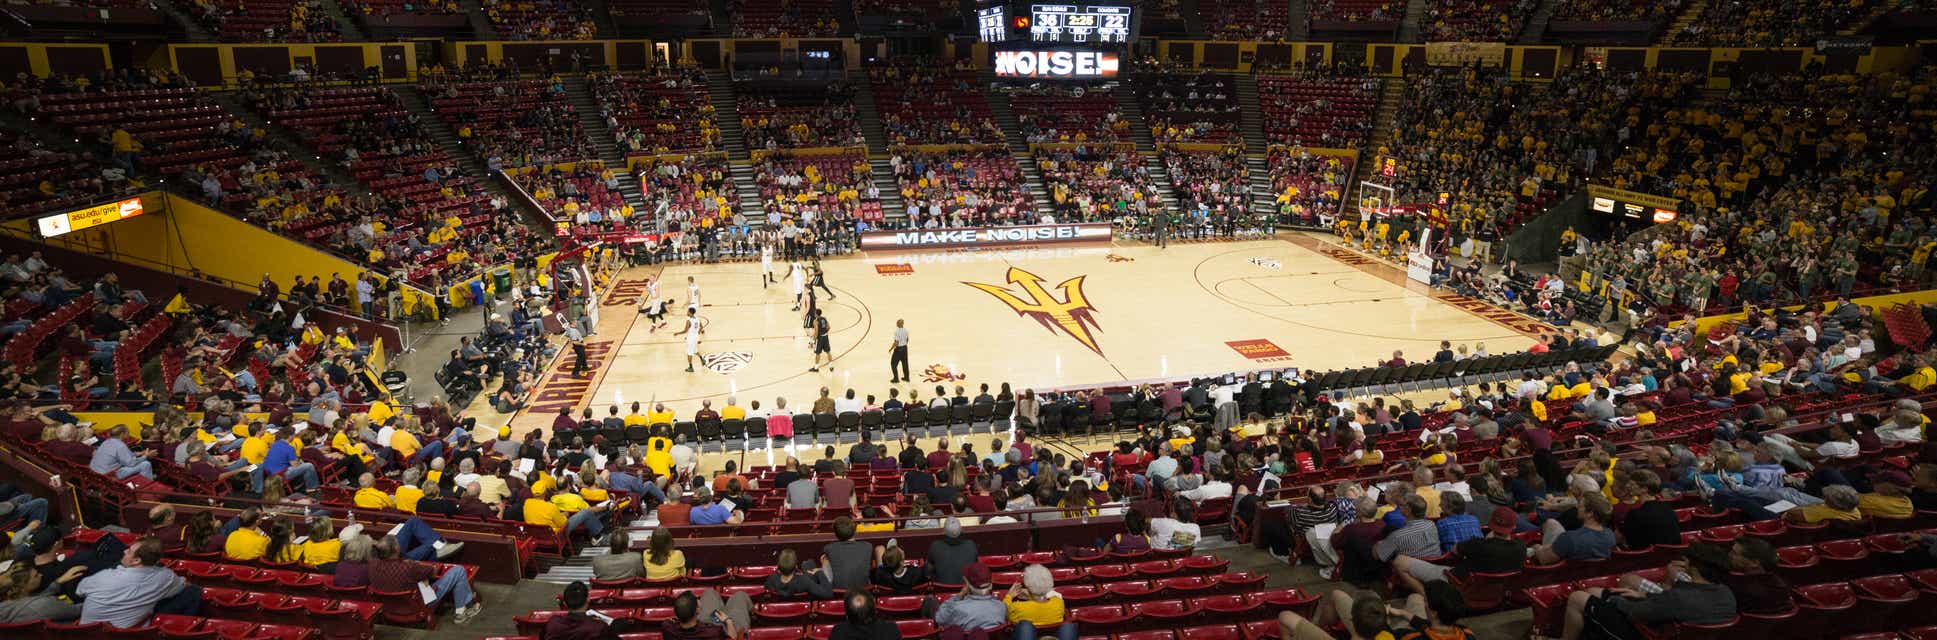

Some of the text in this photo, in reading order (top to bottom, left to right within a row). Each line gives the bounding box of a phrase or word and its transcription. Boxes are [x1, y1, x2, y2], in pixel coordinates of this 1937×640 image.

[1038, 14, 1057, 26] 36
[1068, 15, 1094, 26] 2:25
[1105, 15, 1124, 28] 22
[995, 51, 1103, 75] NOISE!
[1384, 165, 1394, 175] 24
[72, 207, 116, 221] asu.edu/give
[896, 226, 1080, 245] MAKE NOISE!
[1437, 294, 1556, 334] DEVILS
[528, 340, 615, 413] ARIZONA
